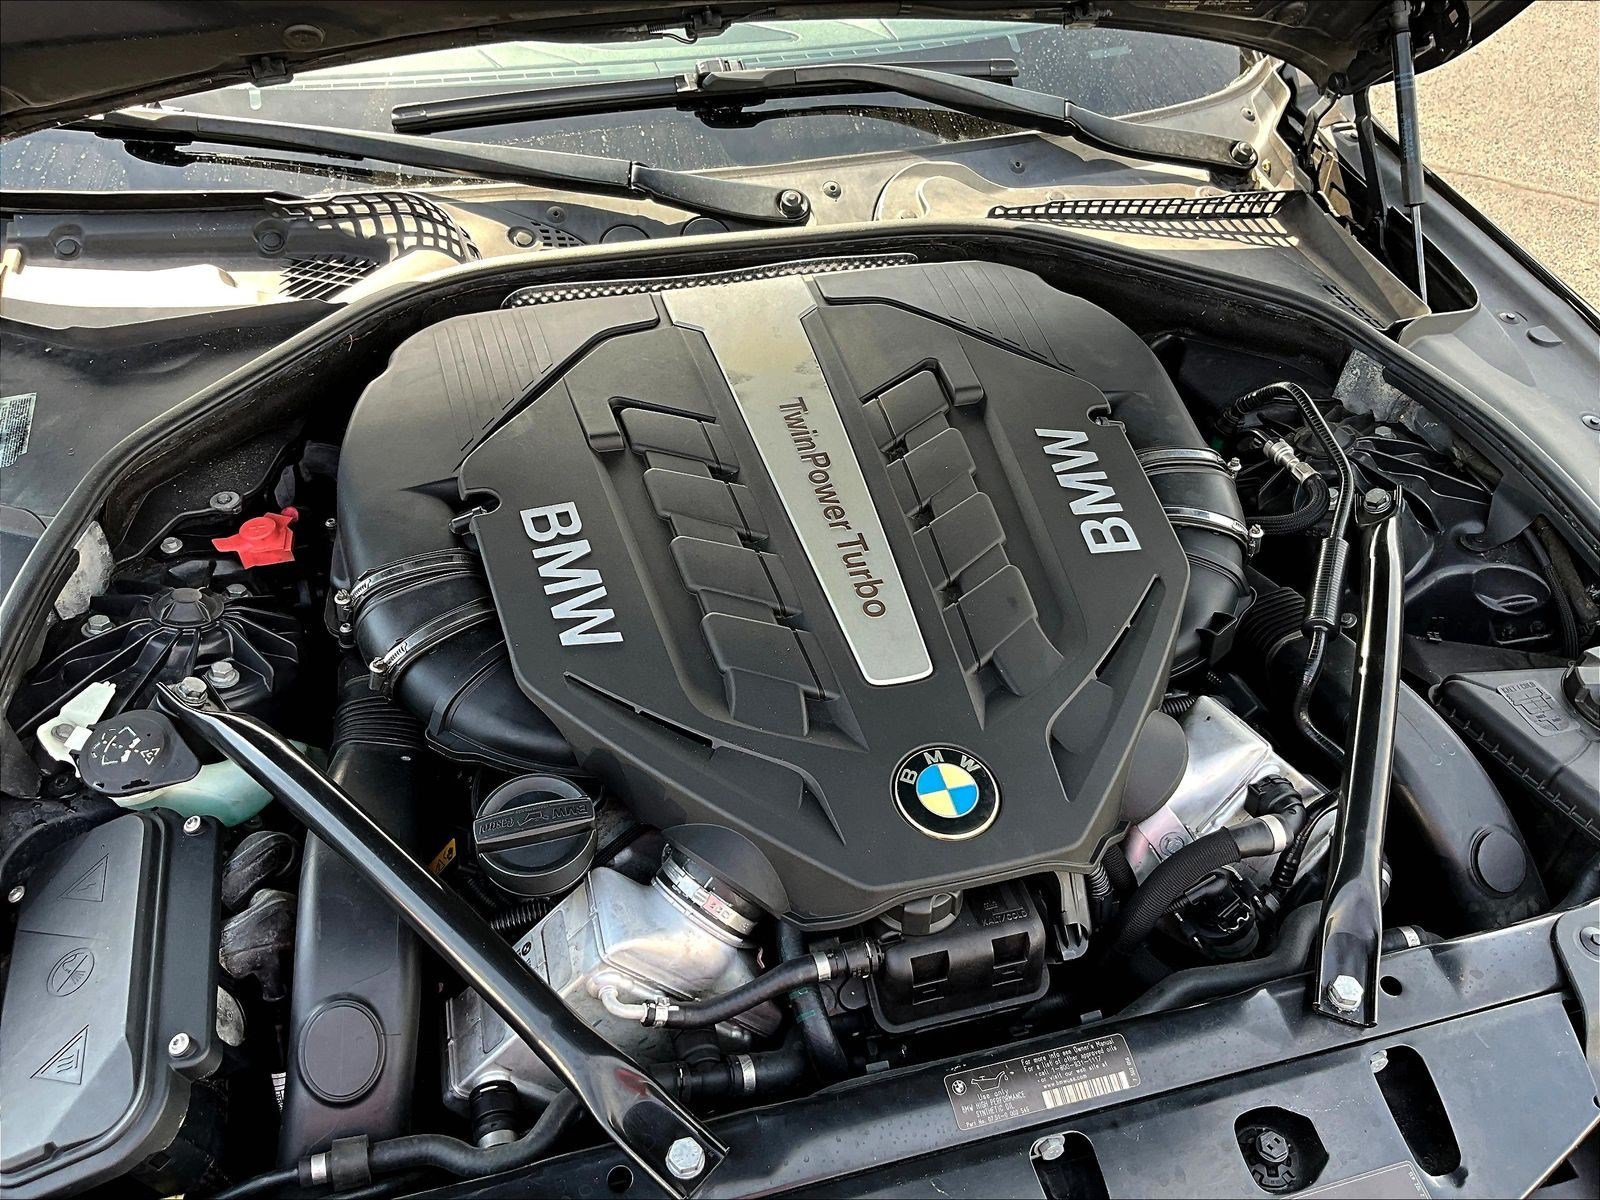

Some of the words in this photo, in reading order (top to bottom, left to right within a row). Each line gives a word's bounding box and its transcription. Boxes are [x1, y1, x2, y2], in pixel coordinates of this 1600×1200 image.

[1034, 428, 1142, 554] BMW
[779, 396, 852, 531] TwinPower
[836, 532, 887, 618] Turbo
[519, 501, 624, 646] BMW
[899, 749, 982, 785] BMW
[552, 803, 589, 820] BMW
[479, 817, 515, 835] Castrol
[1073, 1042, 1095, 1053] Owner's
[1095, 1038, 1114, 1048] Manual
[1041, 1060, 1053, 1069] list
[1063, 1055, 1078, 1063] other
[1081, 1047, 1105, 1060] approved
[1106, 1045, 1118, 1053] oils
[1076, 1066, 1087, 1074] web
[977, 1092, 991, 1101] Use
[993, 1087, 1009, 1098] only
[990, 1090, 1027, 1106] PERFORMANCE
[976, 1103, 1004, 1118] SYNTHETIC
